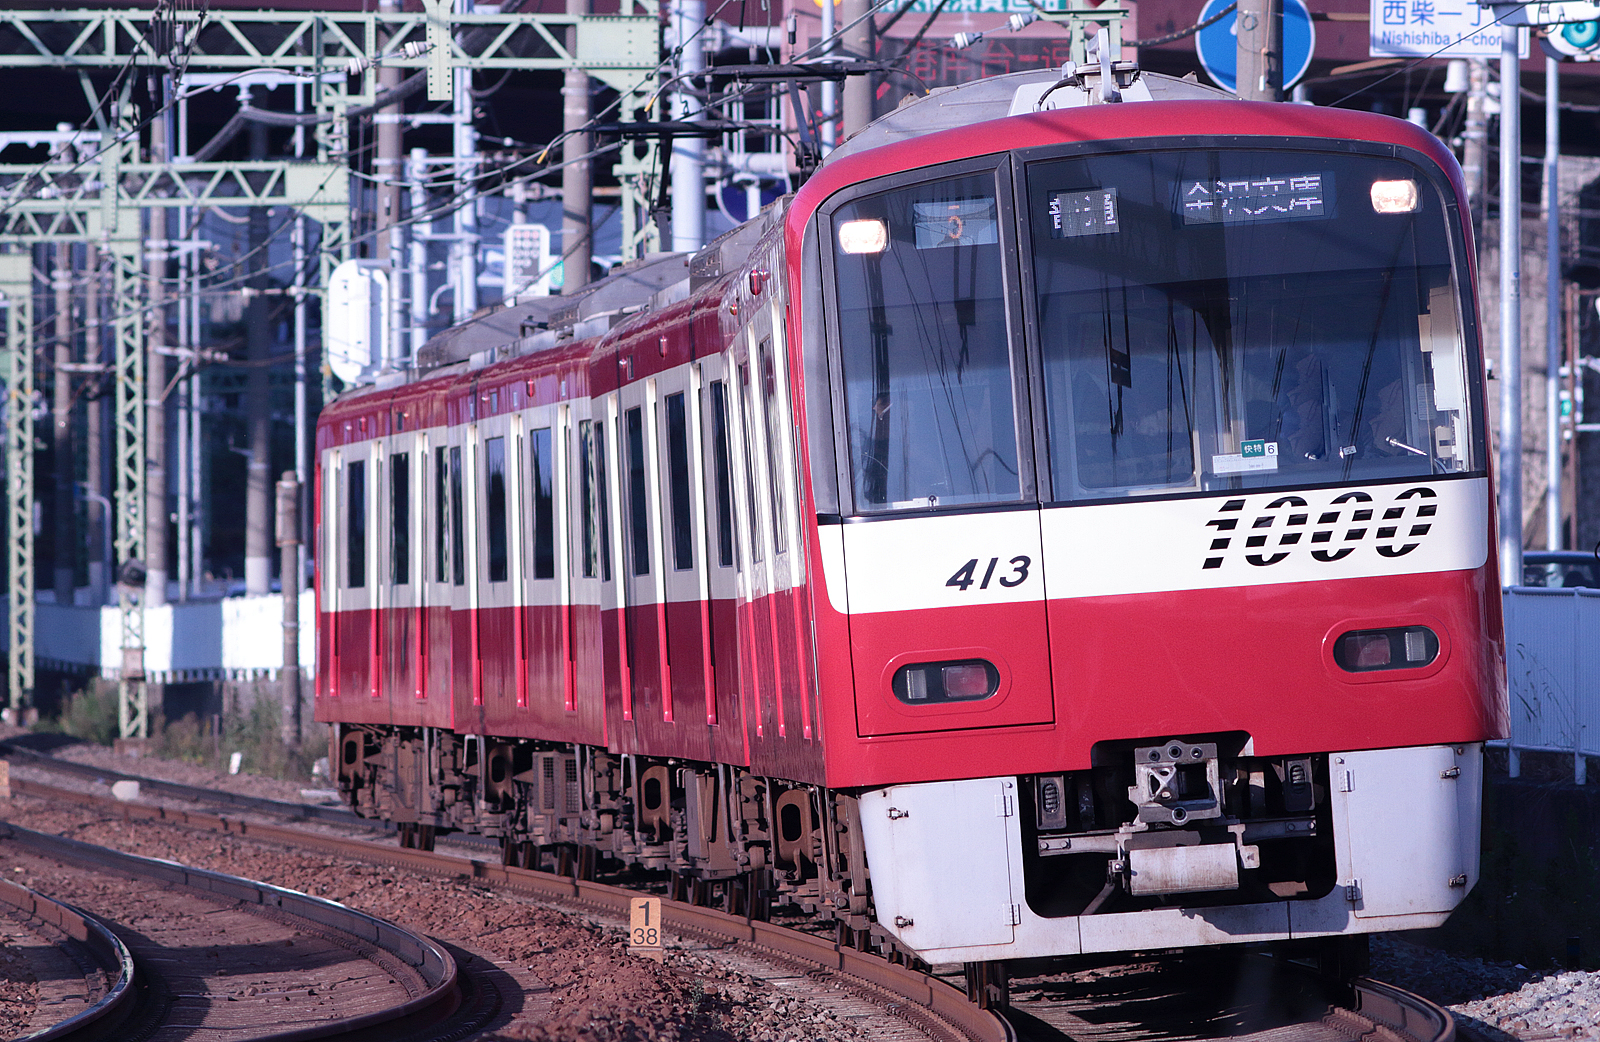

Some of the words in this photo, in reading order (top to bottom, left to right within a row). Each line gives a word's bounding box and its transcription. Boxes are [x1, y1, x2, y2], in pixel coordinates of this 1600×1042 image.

[1383, 0, 1501, 27] 西柴一丁
[1382, 31, 1450, 46] Nishishiba
[1267, 444, 1275, 454] 6
[1202, 487, 1438, 569] 1000
[945, 555, 1032, 591] 413
[638, 901, 650, 927] 1
[633, 927, 658, 945] 38
